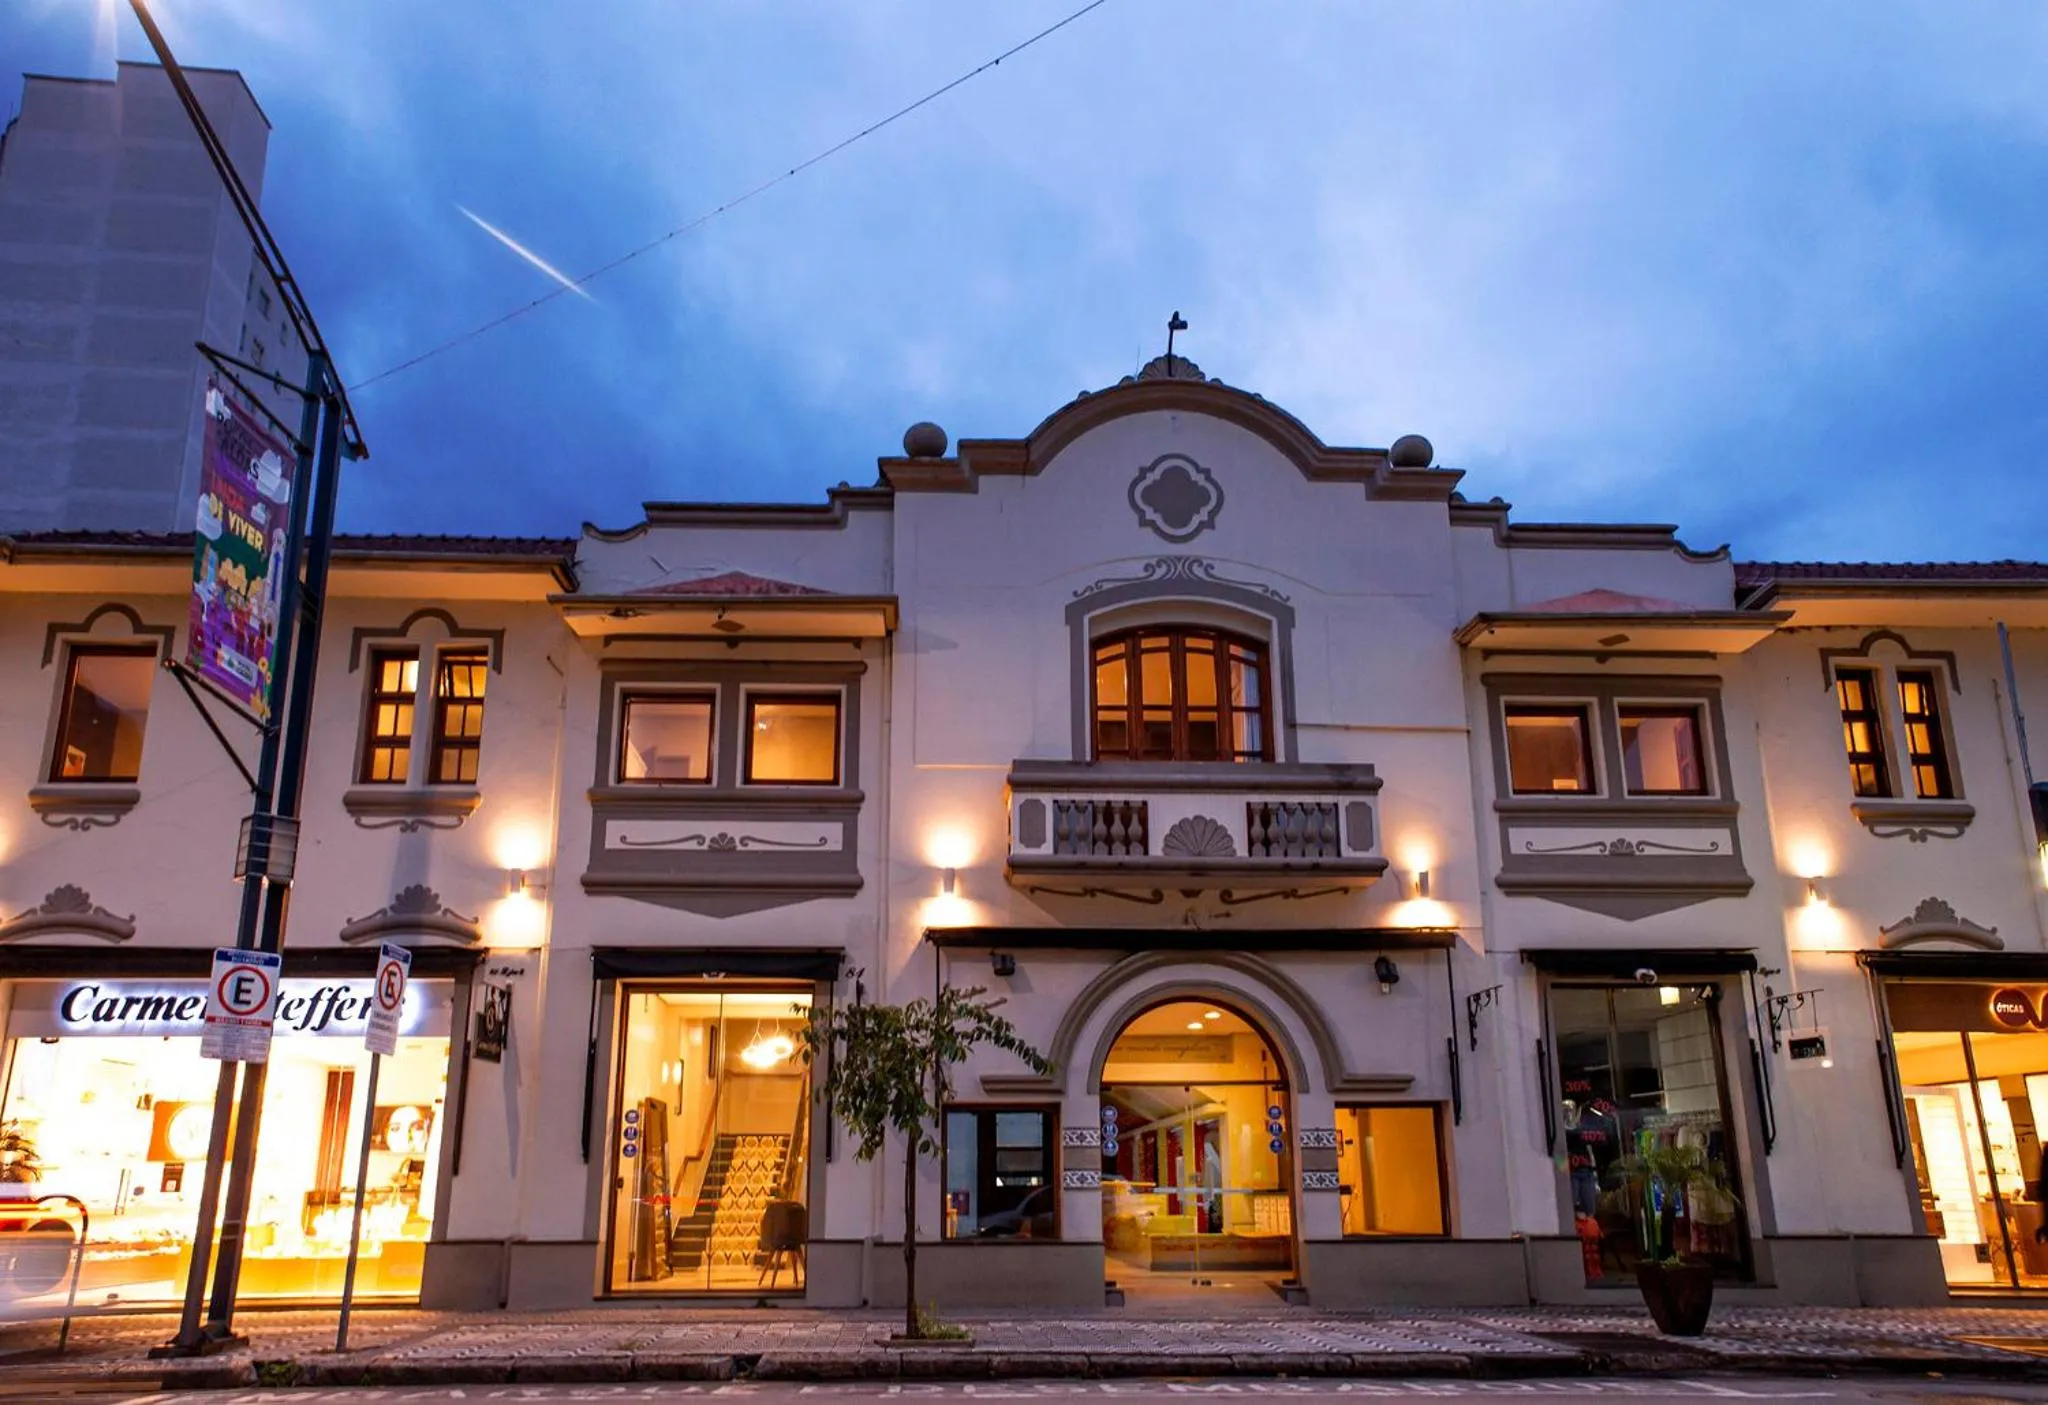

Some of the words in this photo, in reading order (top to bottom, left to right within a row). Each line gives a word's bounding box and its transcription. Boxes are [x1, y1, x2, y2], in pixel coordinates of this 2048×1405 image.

[228, 509, 263, 552] VIVER
[233, 976, 255, 1006] E
[1996, 1001, 2025, 1014] ÓTICAS
